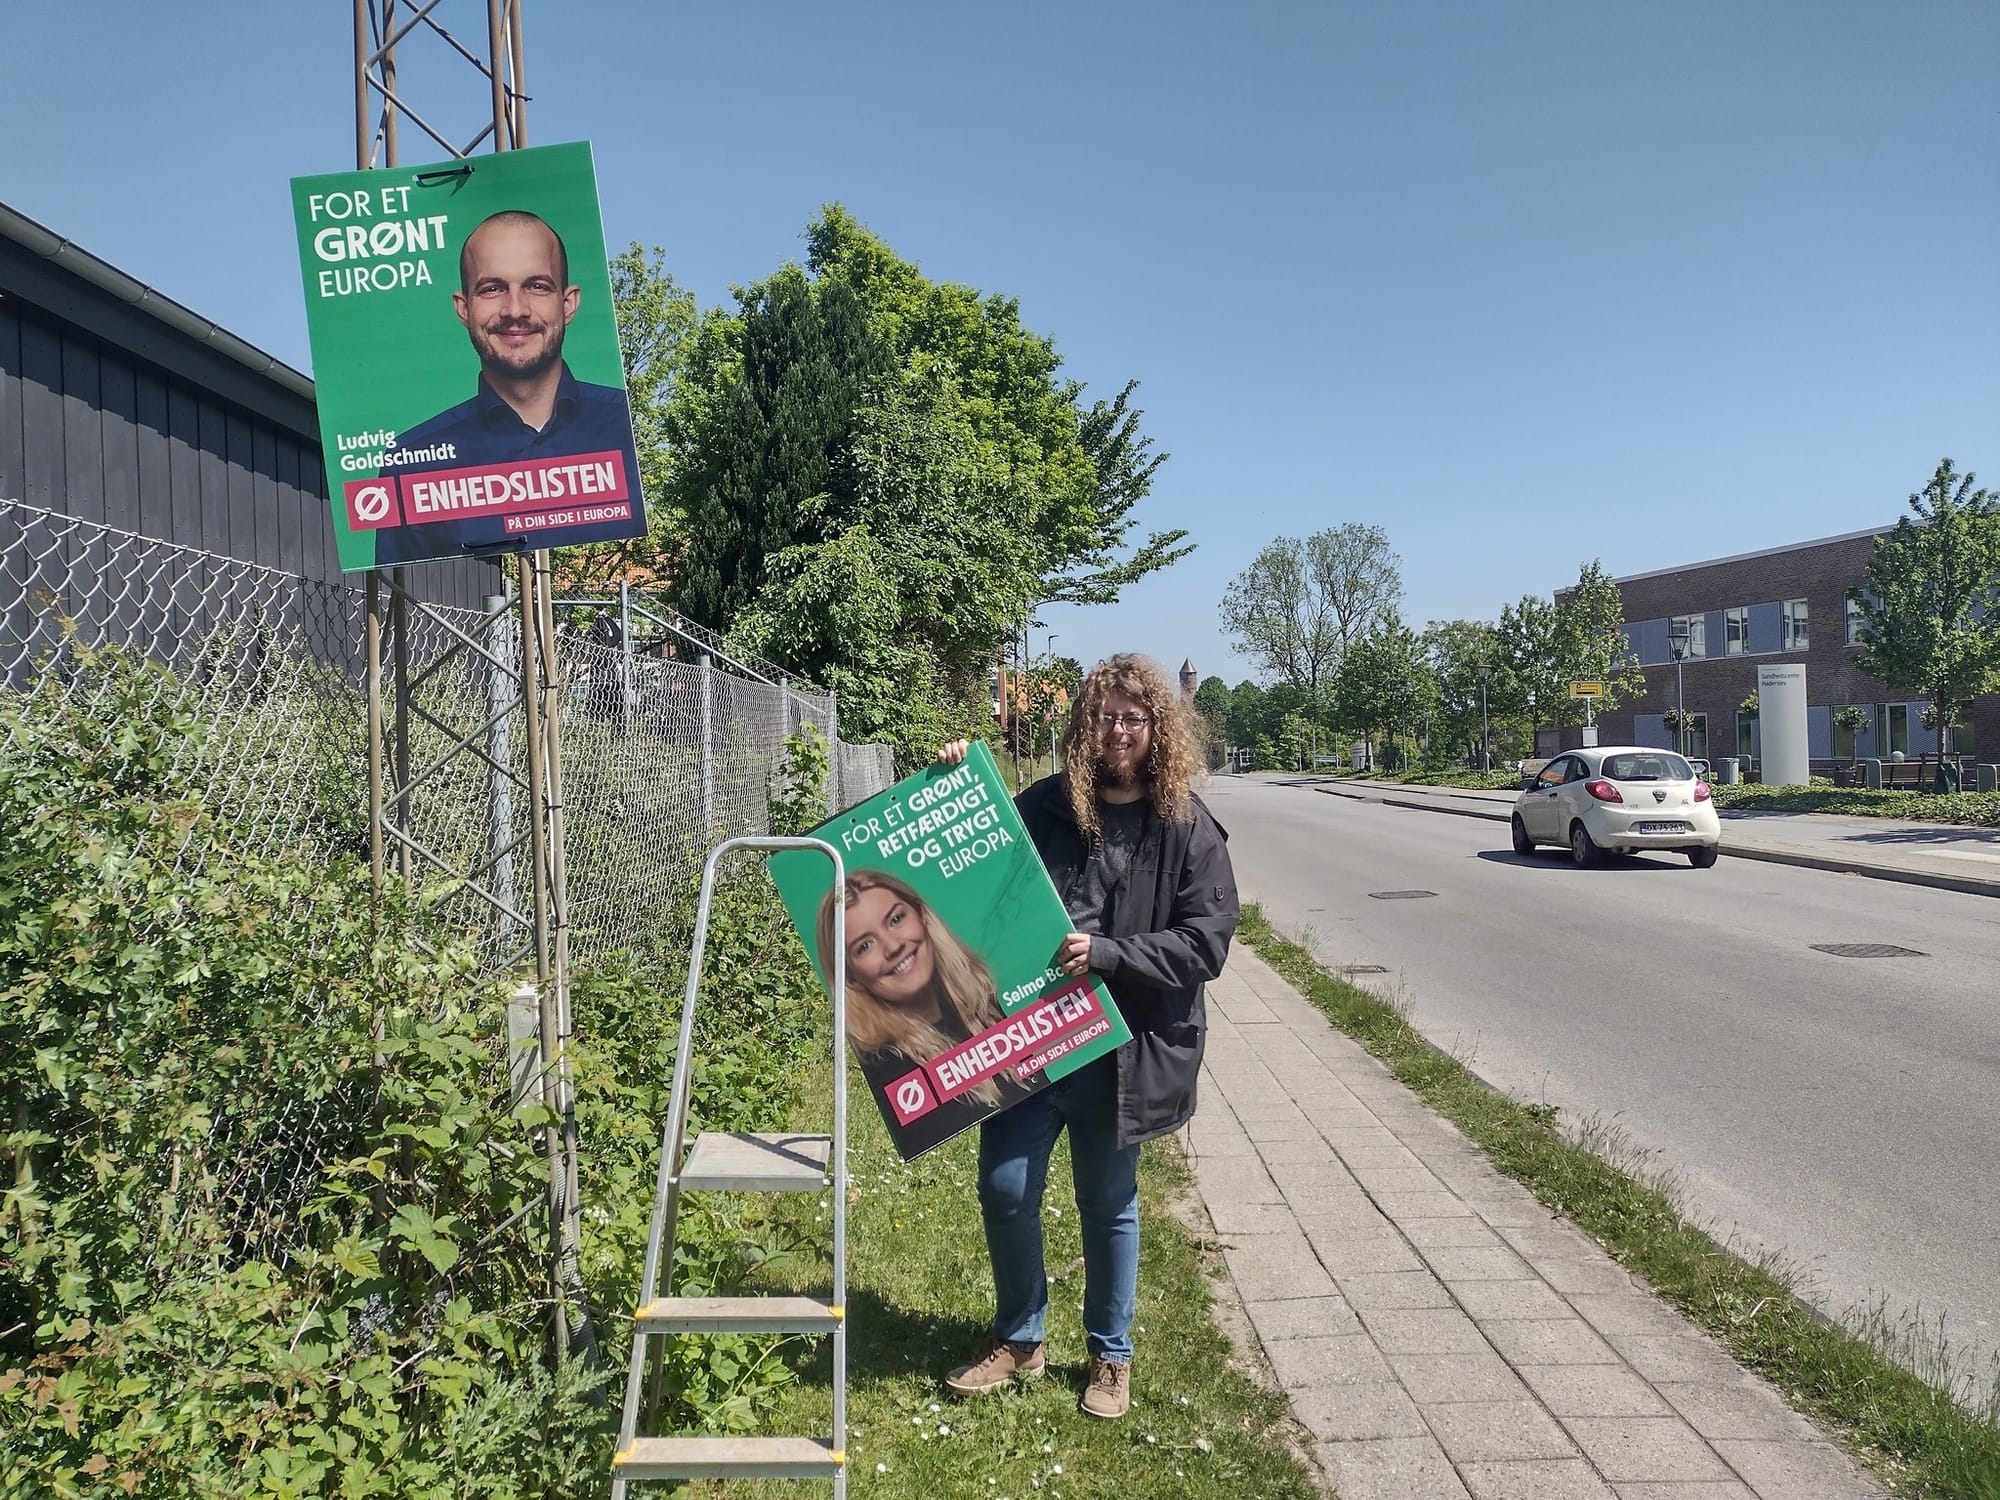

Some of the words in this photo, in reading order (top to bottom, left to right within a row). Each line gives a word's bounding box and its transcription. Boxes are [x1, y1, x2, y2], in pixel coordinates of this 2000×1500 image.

[309, 190, 373, 221] FOR
[381, 186, 411, 214] ET
[314, 215, 448, 262] GRØNT
[319, 259, 432, 297] EUROPA
[337, 429, 397, 450] Ludvig
[340, 443, 456, 471] Goldschmidt
[412, 461, 616, 513] ENHEDSLISTEN
[508, 517, 522, 530] PÅ
[525, 515, 546, 528] DIN
[549, 512, 574, 525] SIDE
[576, 511, 581, 522] I
[584, 506, 628, 521] EUROPA
[841, 817, 884, 851] FOR
[883, 802, 905, 828] ET
[908, 765, 979, 812] GRØNT,
[877, 783, 989, 859] RETFÆRDIGT
[907, 838, 942, 867] OG
[941, 804, 1000, 848] TRYGT
[938, 826, 1014, 879] EUROPA
[1002, 977, 1046, 1007] Selma
[935, 987, 1093, 1091] ENHEDSLISTEN
[1029, 1055, 1048, 1072] DIN
[1048, 1043, 1069, 1060] SIDE
[1069, 1039, 1074, 1048] I
[1072, 1020, 1110, 1046] EUROPA
